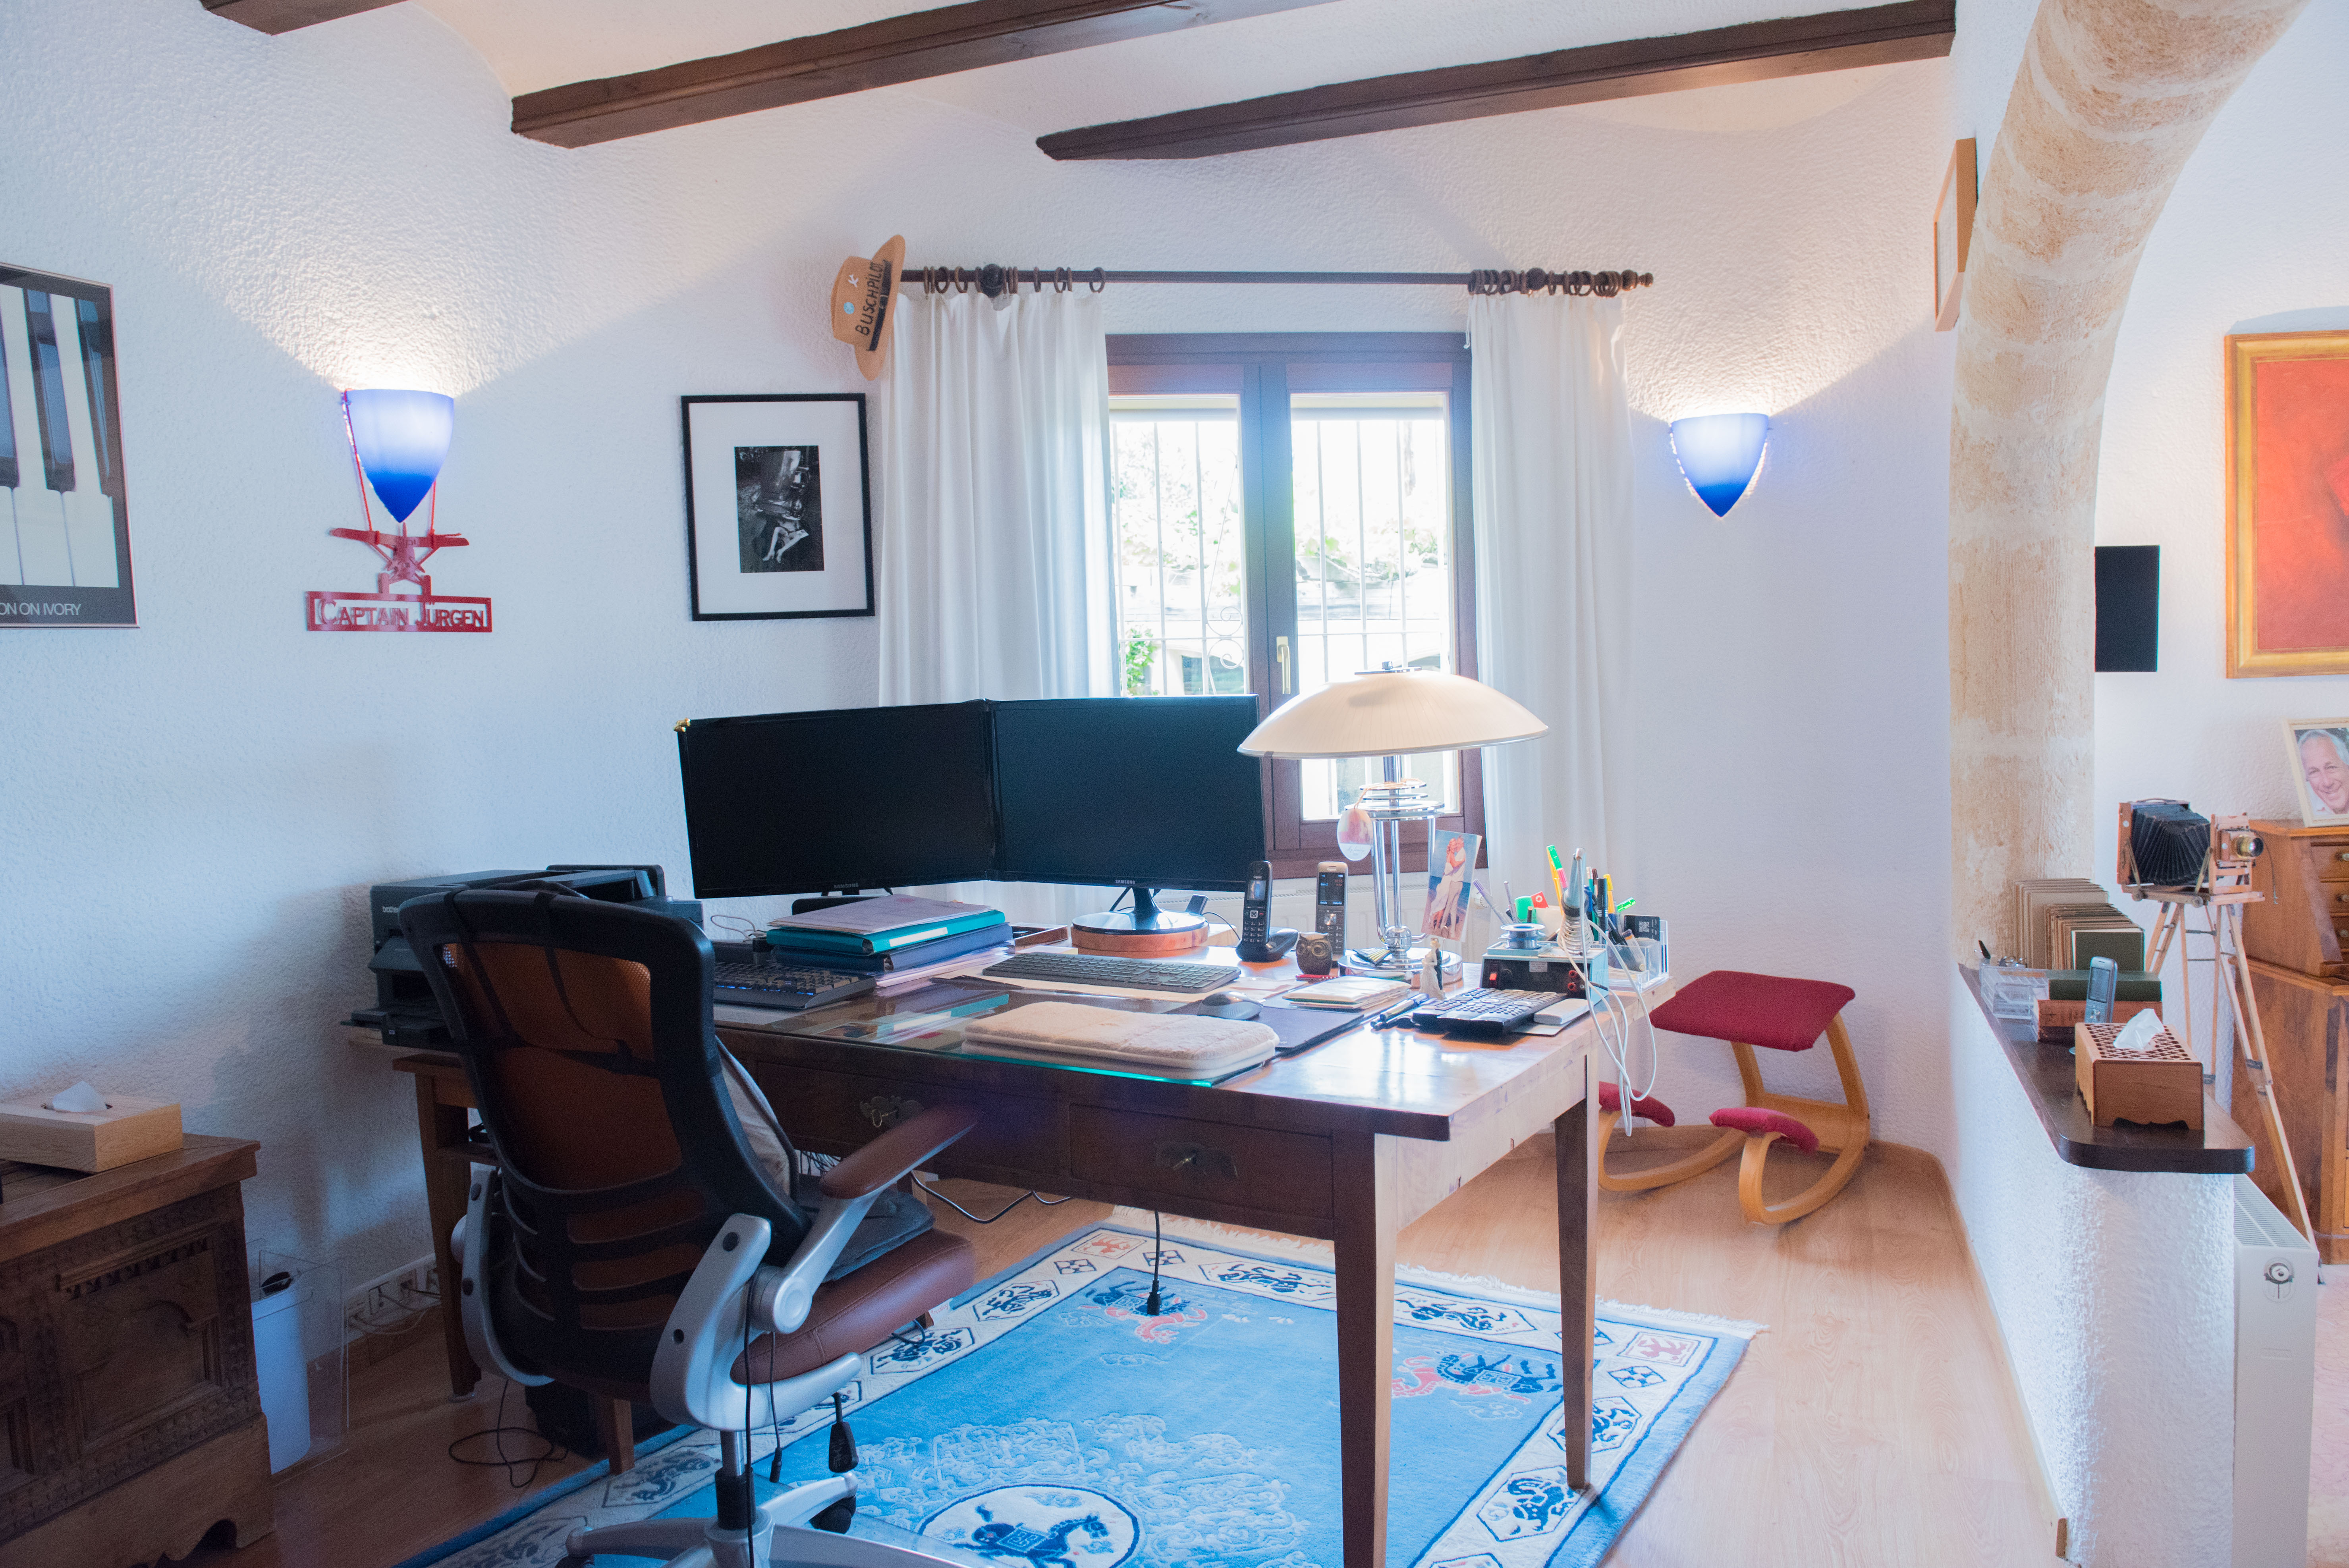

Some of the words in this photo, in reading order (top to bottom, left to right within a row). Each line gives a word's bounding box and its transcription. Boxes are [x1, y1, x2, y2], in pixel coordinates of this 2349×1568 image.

[19, 602, 40, 615] ON
[43, 603, 82, 615] IVORY
[320, 598, 409, 626] CAPTAIN
[415, 600, 484, 627] JÜRGEN
